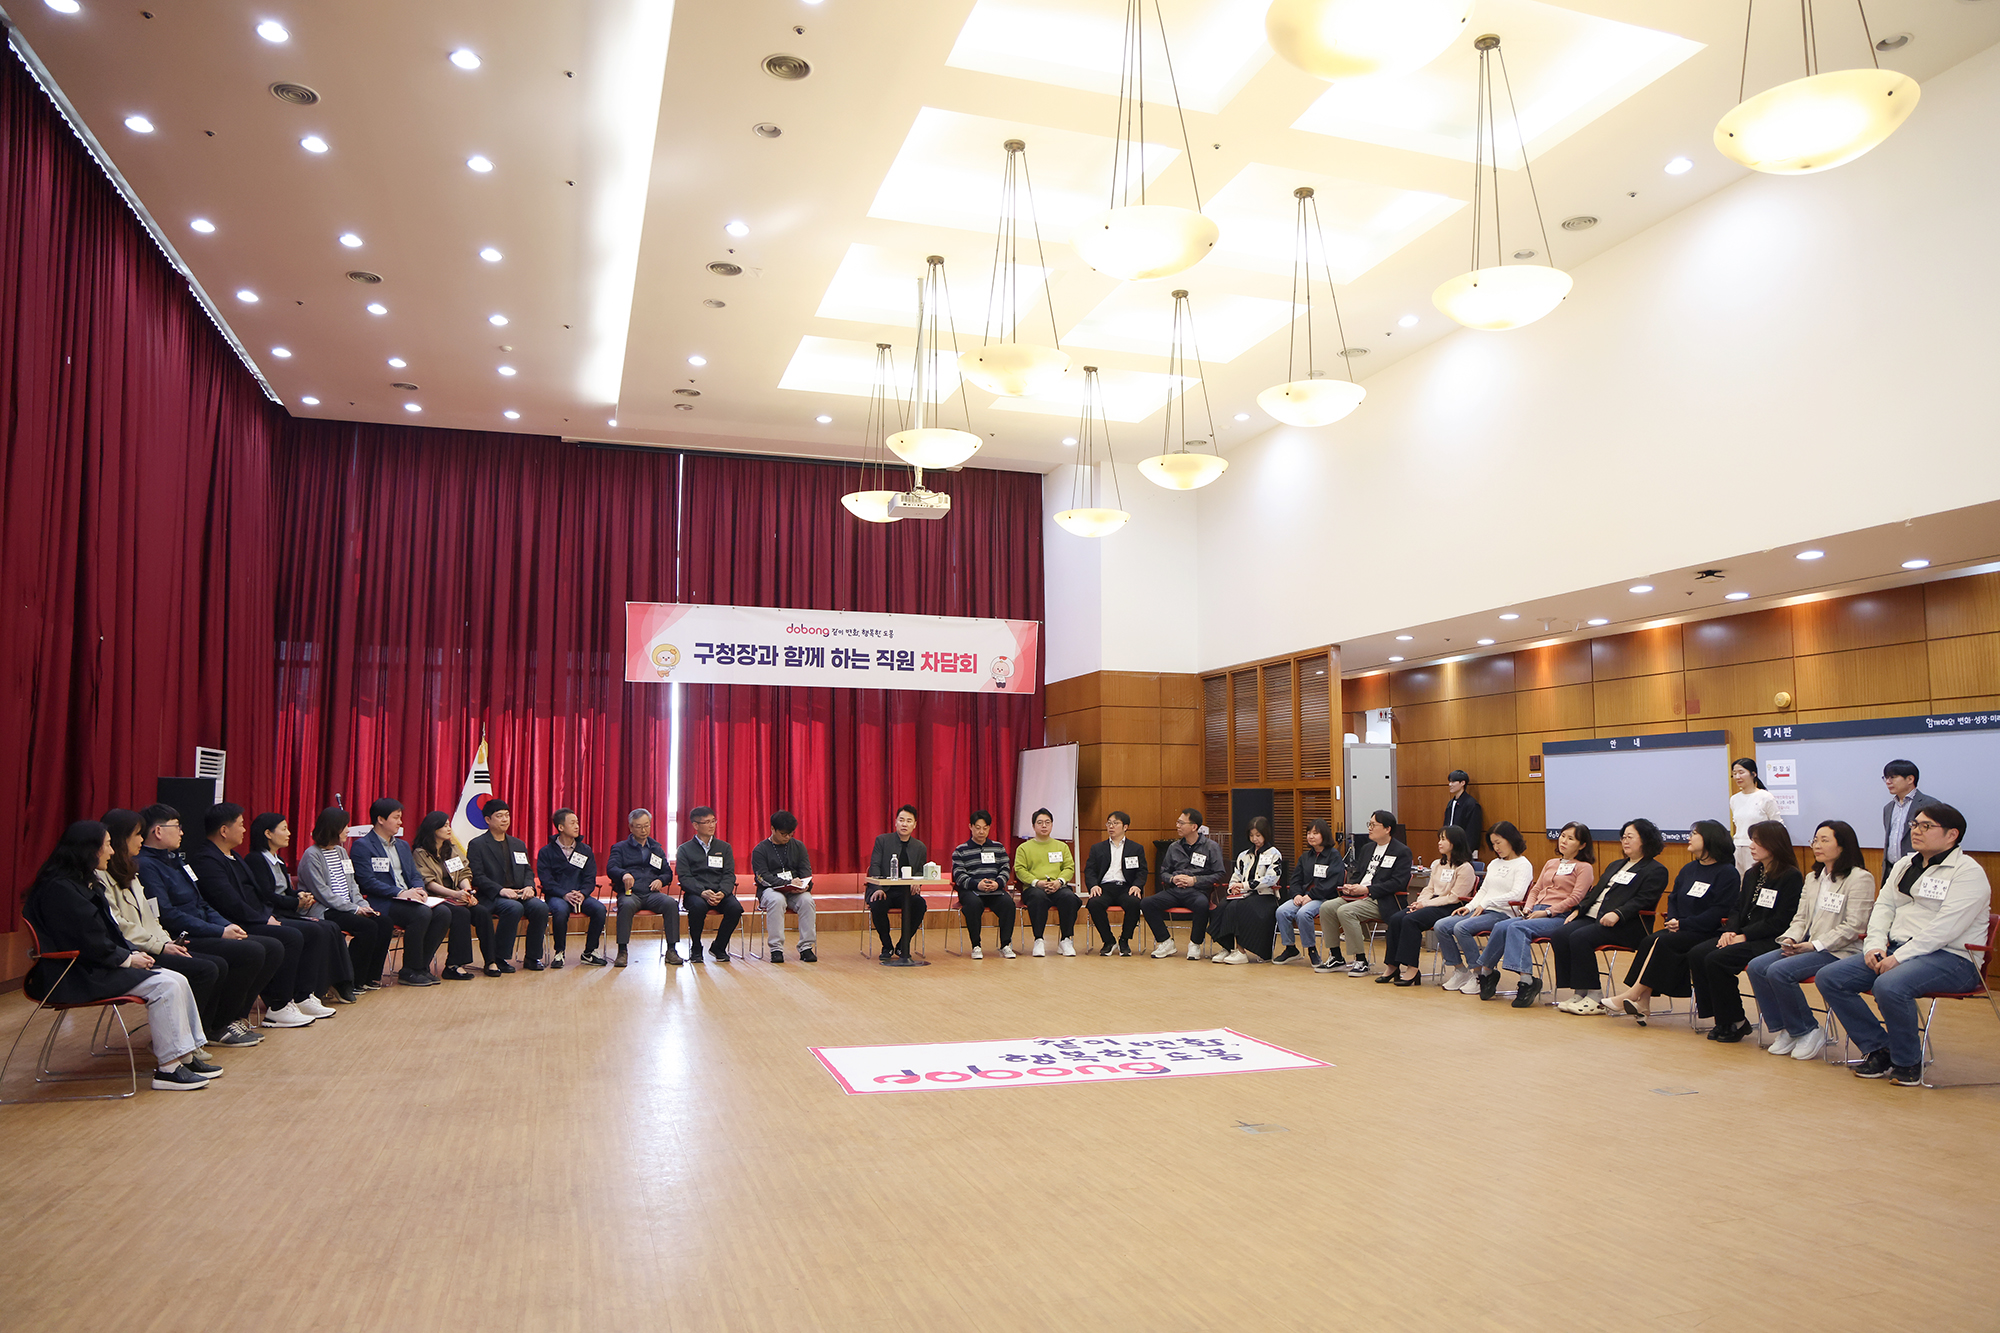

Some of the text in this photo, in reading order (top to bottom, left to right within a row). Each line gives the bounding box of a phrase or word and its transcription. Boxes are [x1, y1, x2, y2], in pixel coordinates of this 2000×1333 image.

[786, 623, 830, 638] dobong
[831, 628, 844, 636] 같이
[861, 628, 882, 638] 행복한
[883, 629, 894, 639] 도봉
[693, 642, 978, 674] 구청장과 함께 하는 직원 차담회
[1763, 726, 1793, 739] 게시판
[1548, 830, 1560, 839] dob
[1033, 1038, 1121, 1049] 같이
[998, 1048, 1243, 1065] 행복한 도봉
[872, 1061, 1172, 1085] dobong
